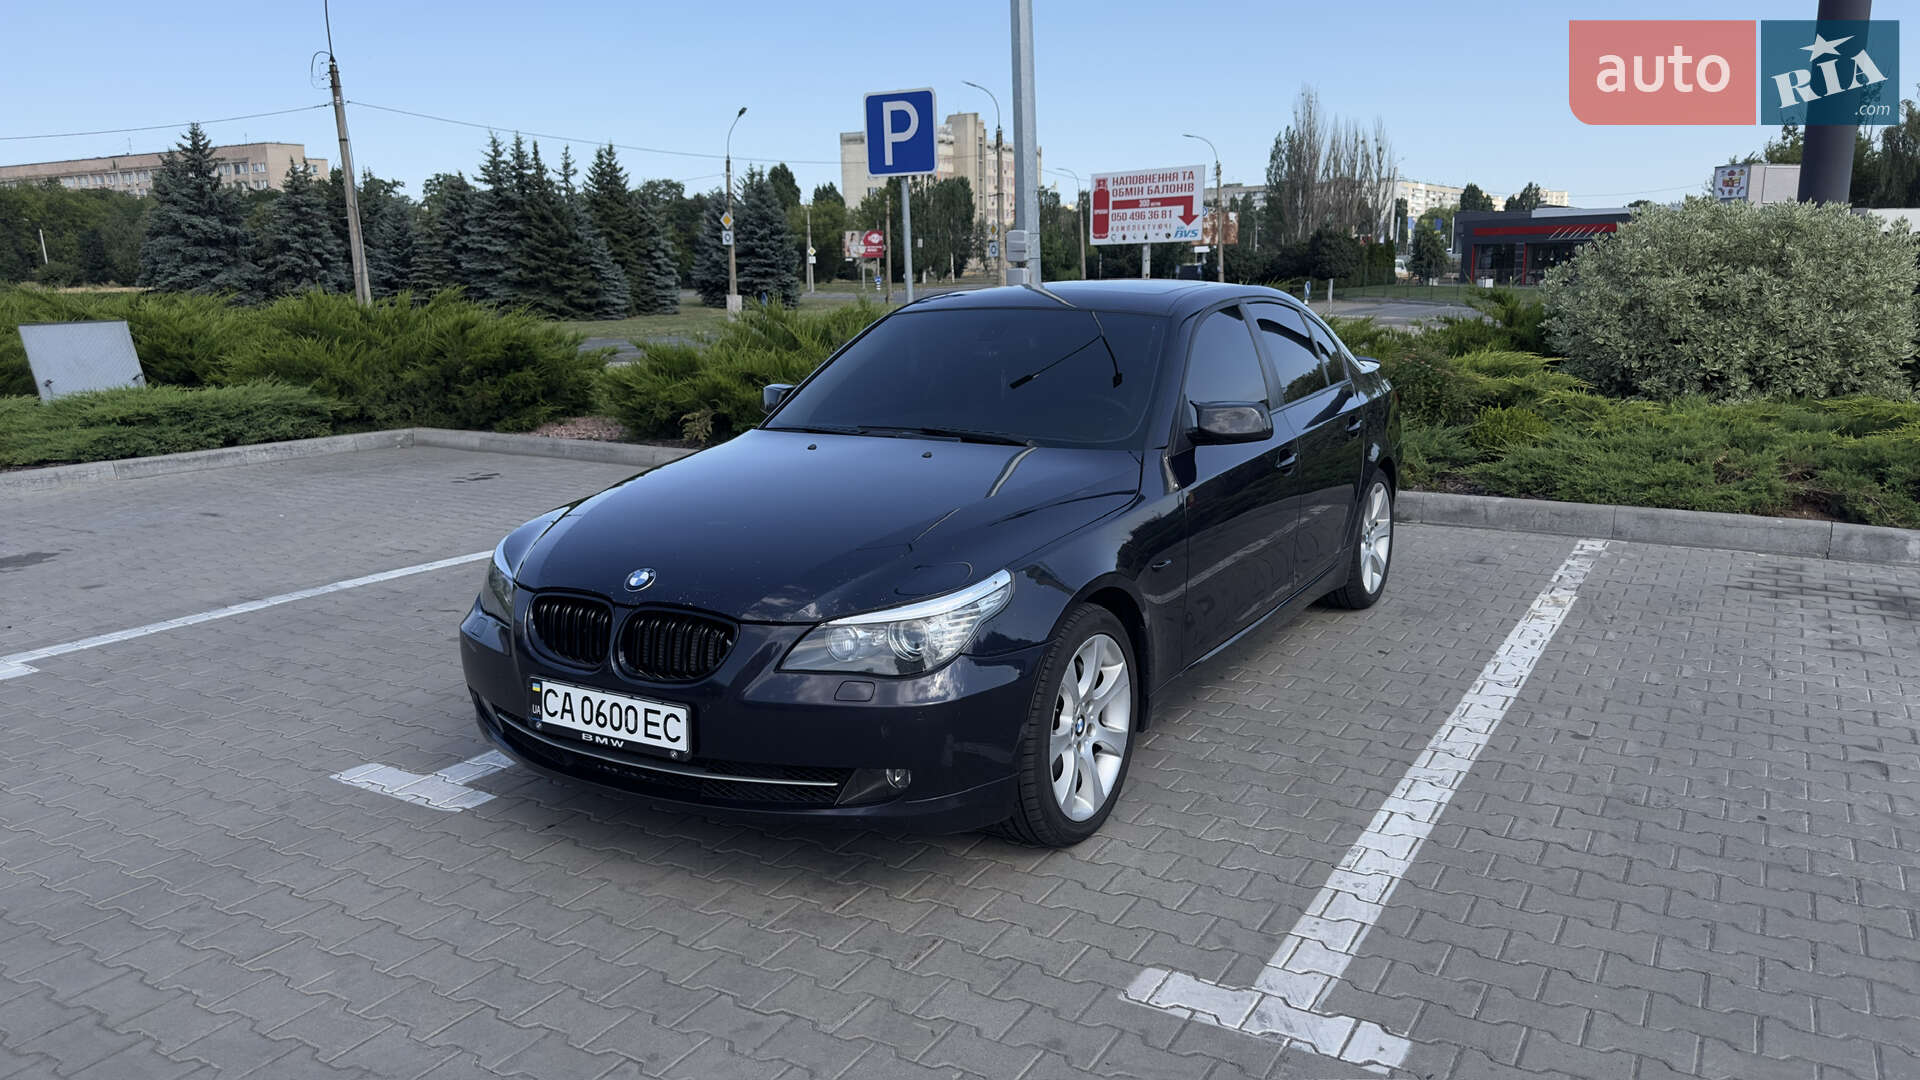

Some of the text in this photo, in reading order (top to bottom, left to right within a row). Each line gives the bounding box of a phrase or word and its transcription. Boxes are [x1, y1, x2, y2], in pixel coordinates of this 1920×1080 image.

[882, 100, 919, 166] P
[1112, 170, 1194, 186] НАПОВНЕННЯ ТА
[1112, 183, 1195, 198] ОБМІН БАЛОНІВ
[1111, 212, 1128, 222] 050
[532, 703, 541, 715] UA
[543, 688, 681, 743] CA 0600 EC
[581, 732, 624, 748] BMW
